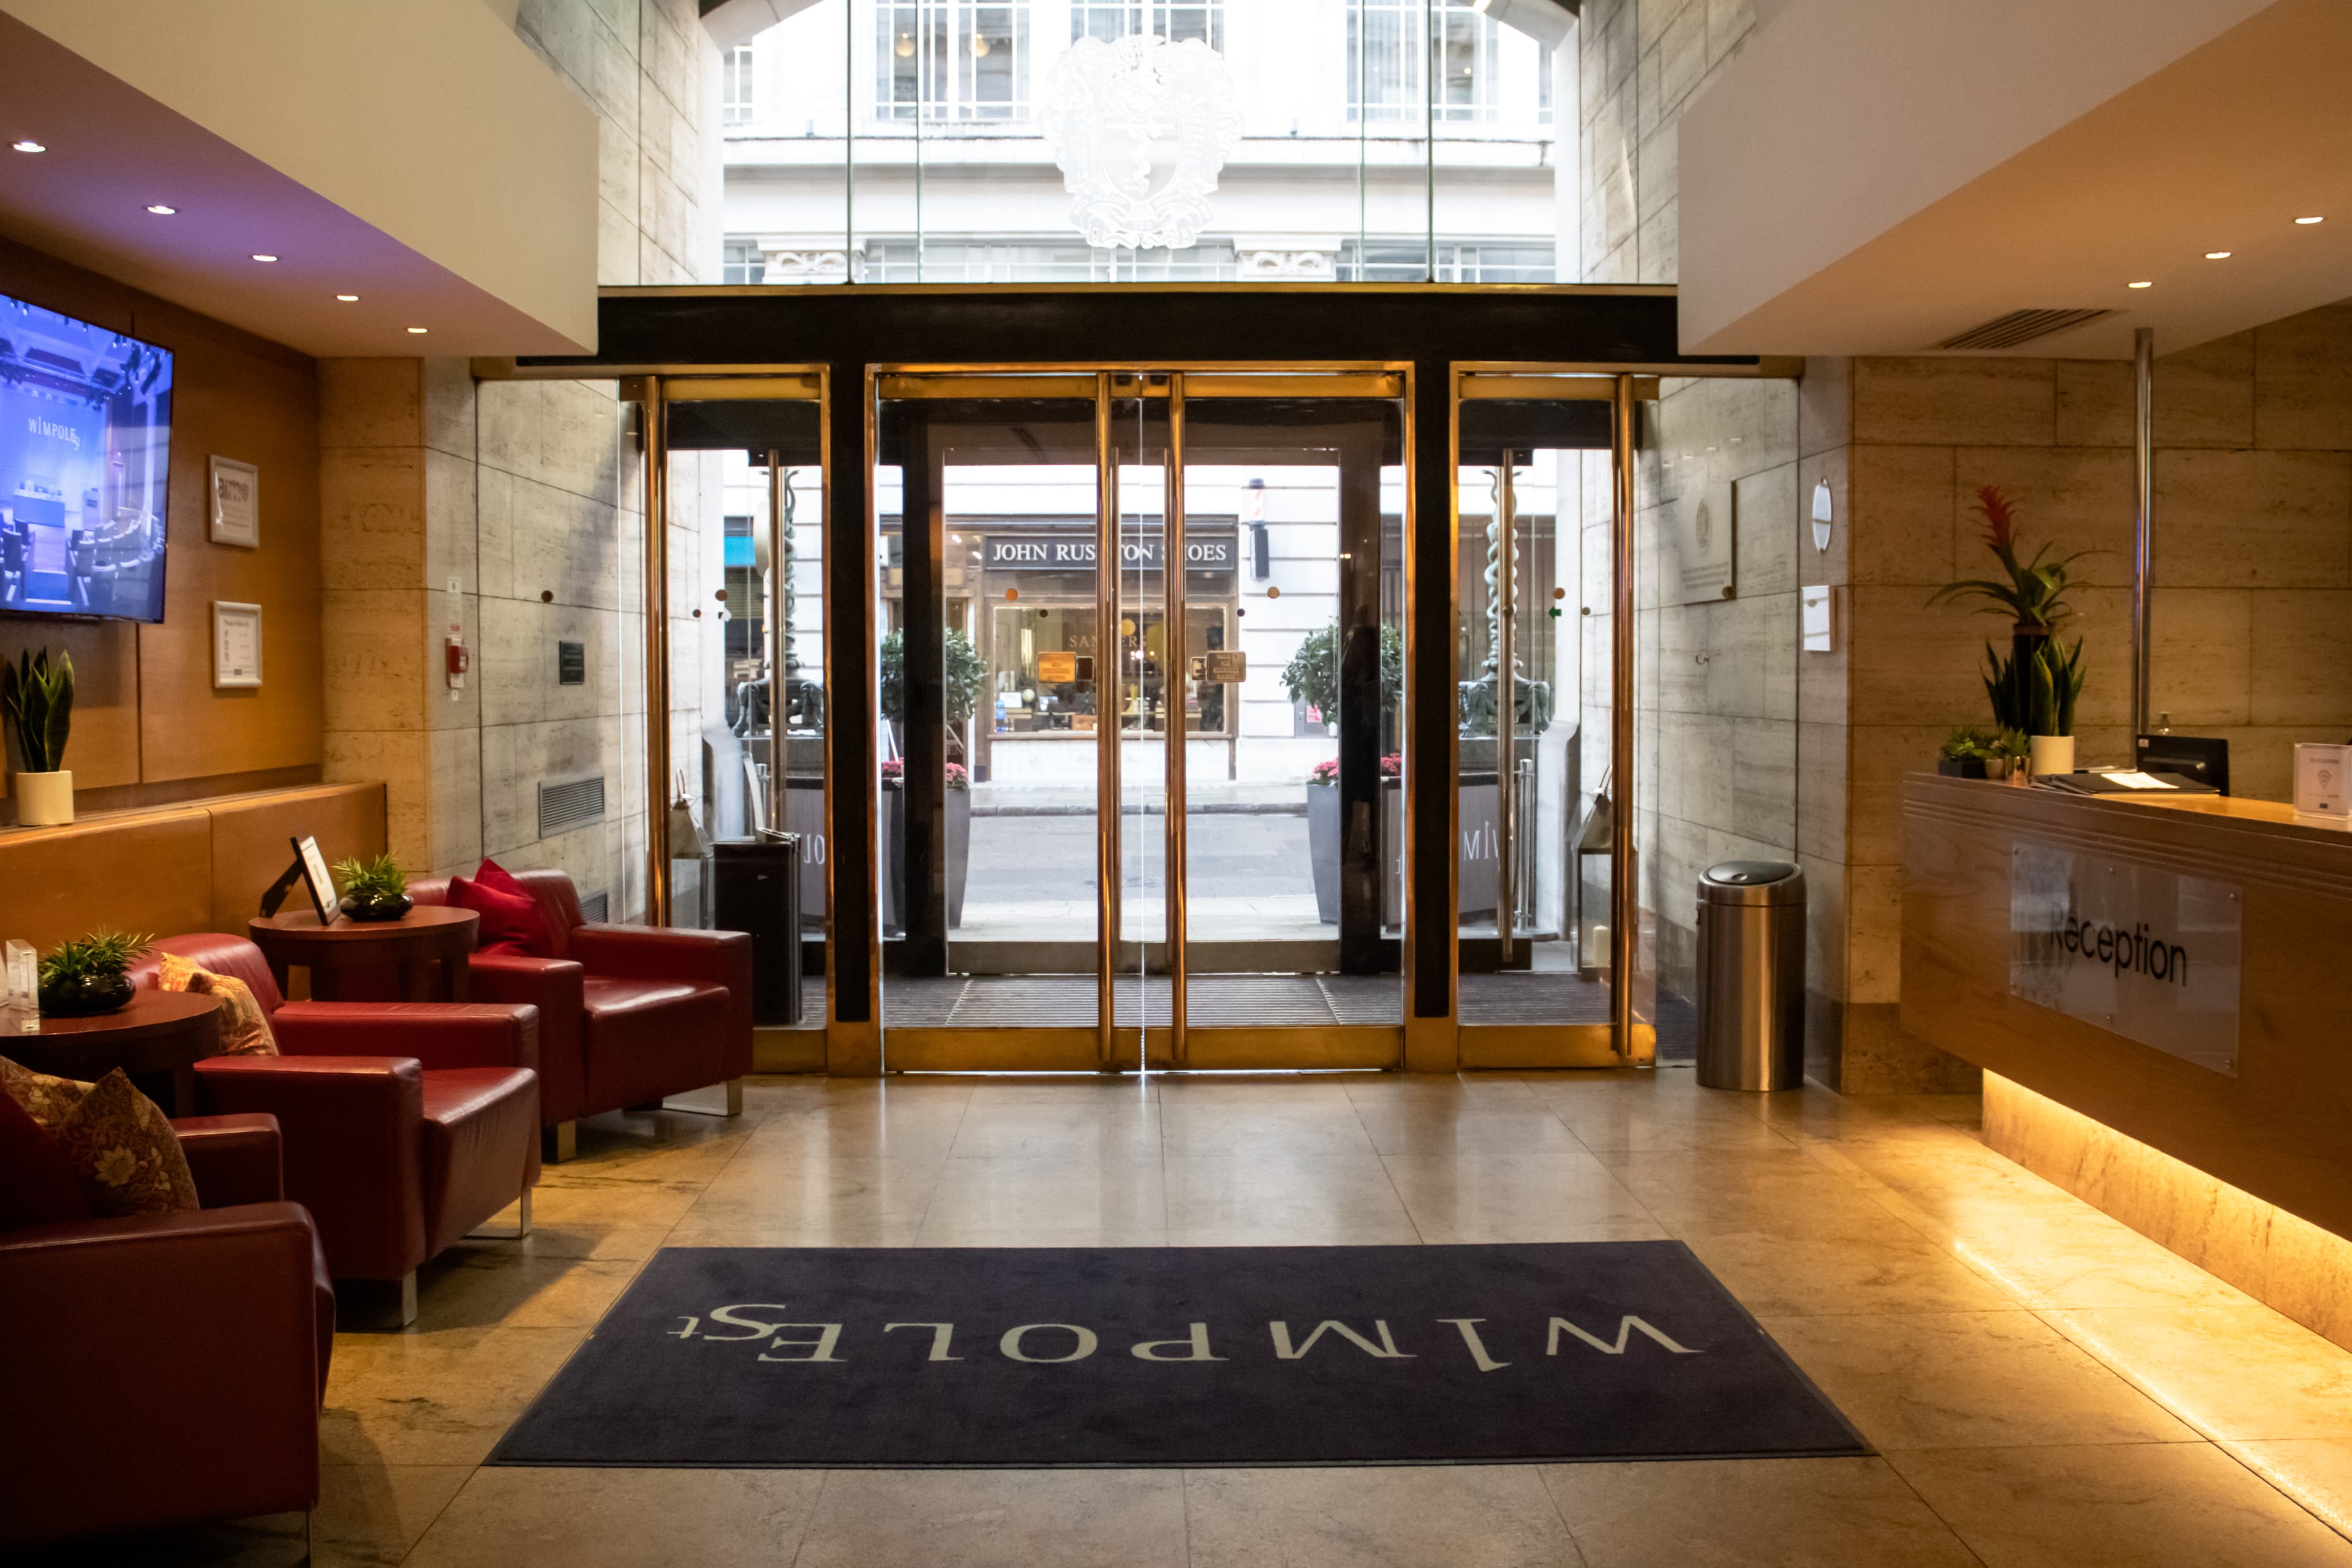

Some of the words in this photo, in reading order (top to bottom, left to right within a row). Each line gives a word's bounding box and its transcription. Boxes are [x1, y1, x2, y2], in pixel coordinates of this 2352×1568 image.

[993, 544, 1049, 561] JOHN
[1055, 544, 1154, 561] RUSON
[1161, 544, 1226, 561] OES
[2049, 901, 2187, 987] Reception
